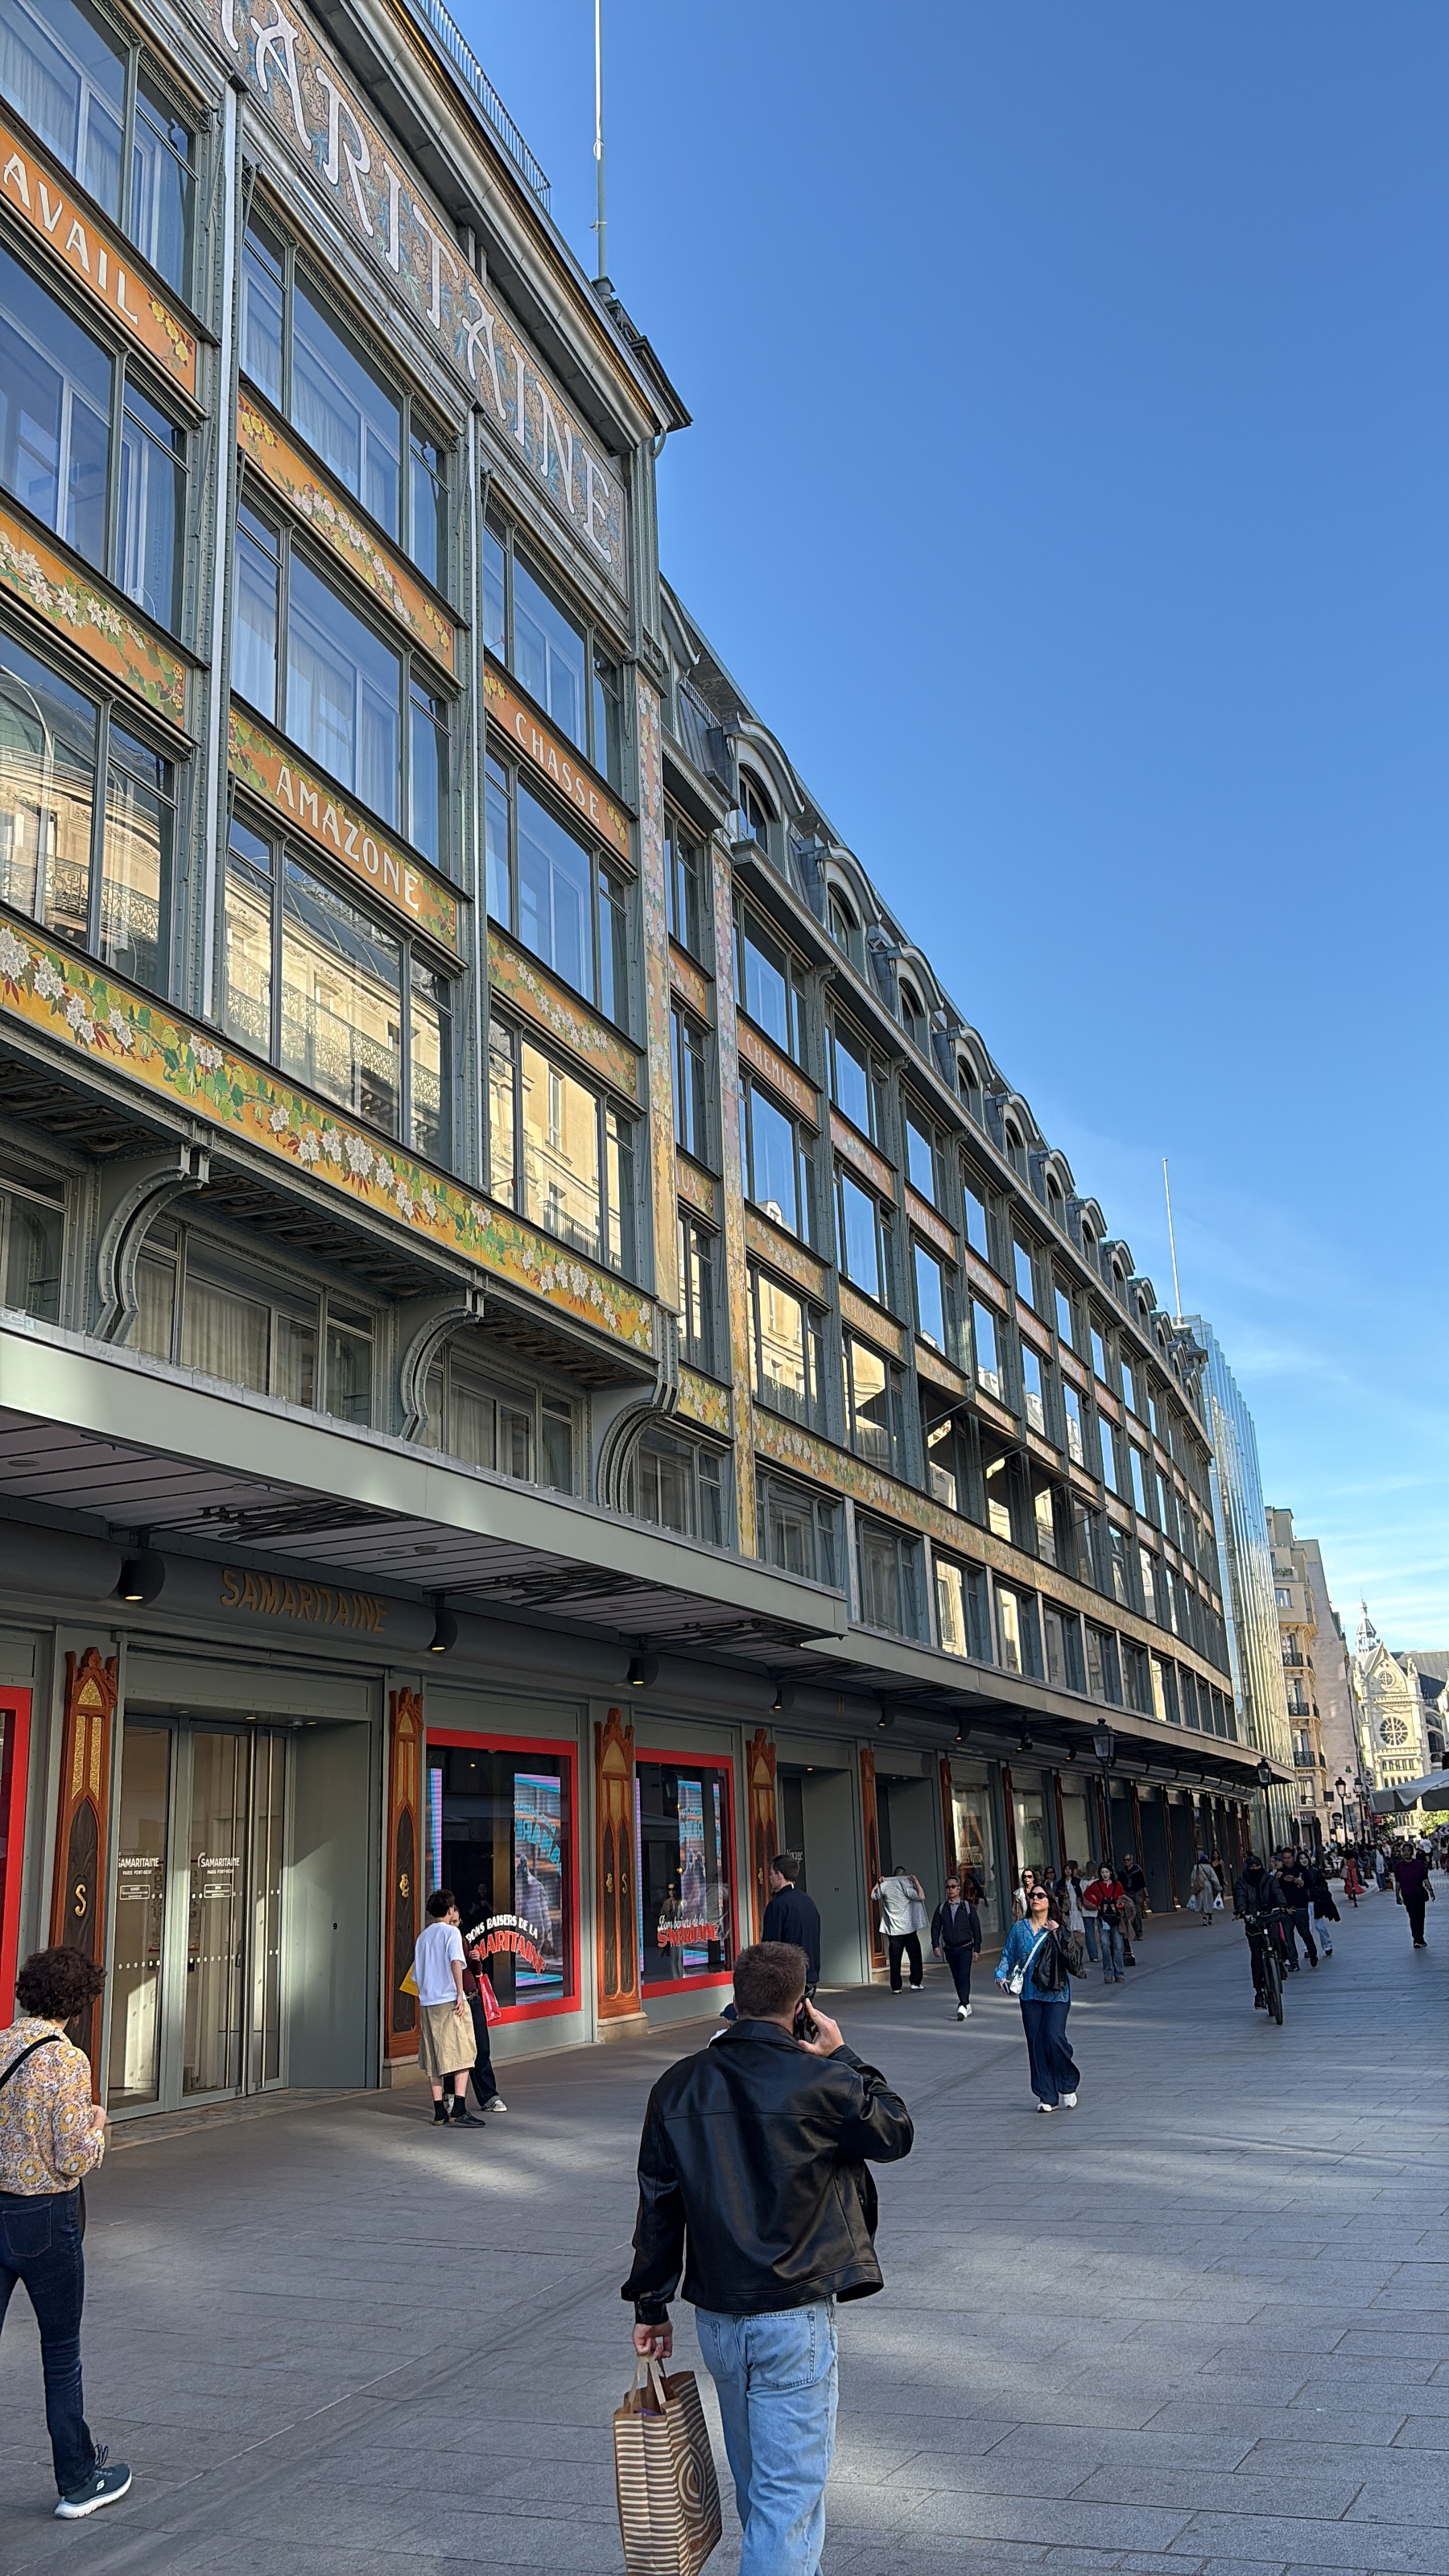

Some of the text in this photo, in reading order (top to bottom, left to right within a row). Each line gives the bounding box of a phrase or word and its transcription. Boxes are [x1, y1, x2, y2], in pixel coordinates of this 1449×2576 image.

[3, 151, 138, 326] AVAIL
[515, 712, 600, 824] CHASSE
[275, 765, 419, 912] AMAZONE
[746, 1034, 801, 1103] CHEMISE
[677, 1166, 699, 1200] UX
[221, 1570, 388, 1633] SAMARITAINE
[486, 1913, 517, 1930] BAISERS
[518, 1917, 528, 1932] DE
[529, 1923, 538, 1940] LA
